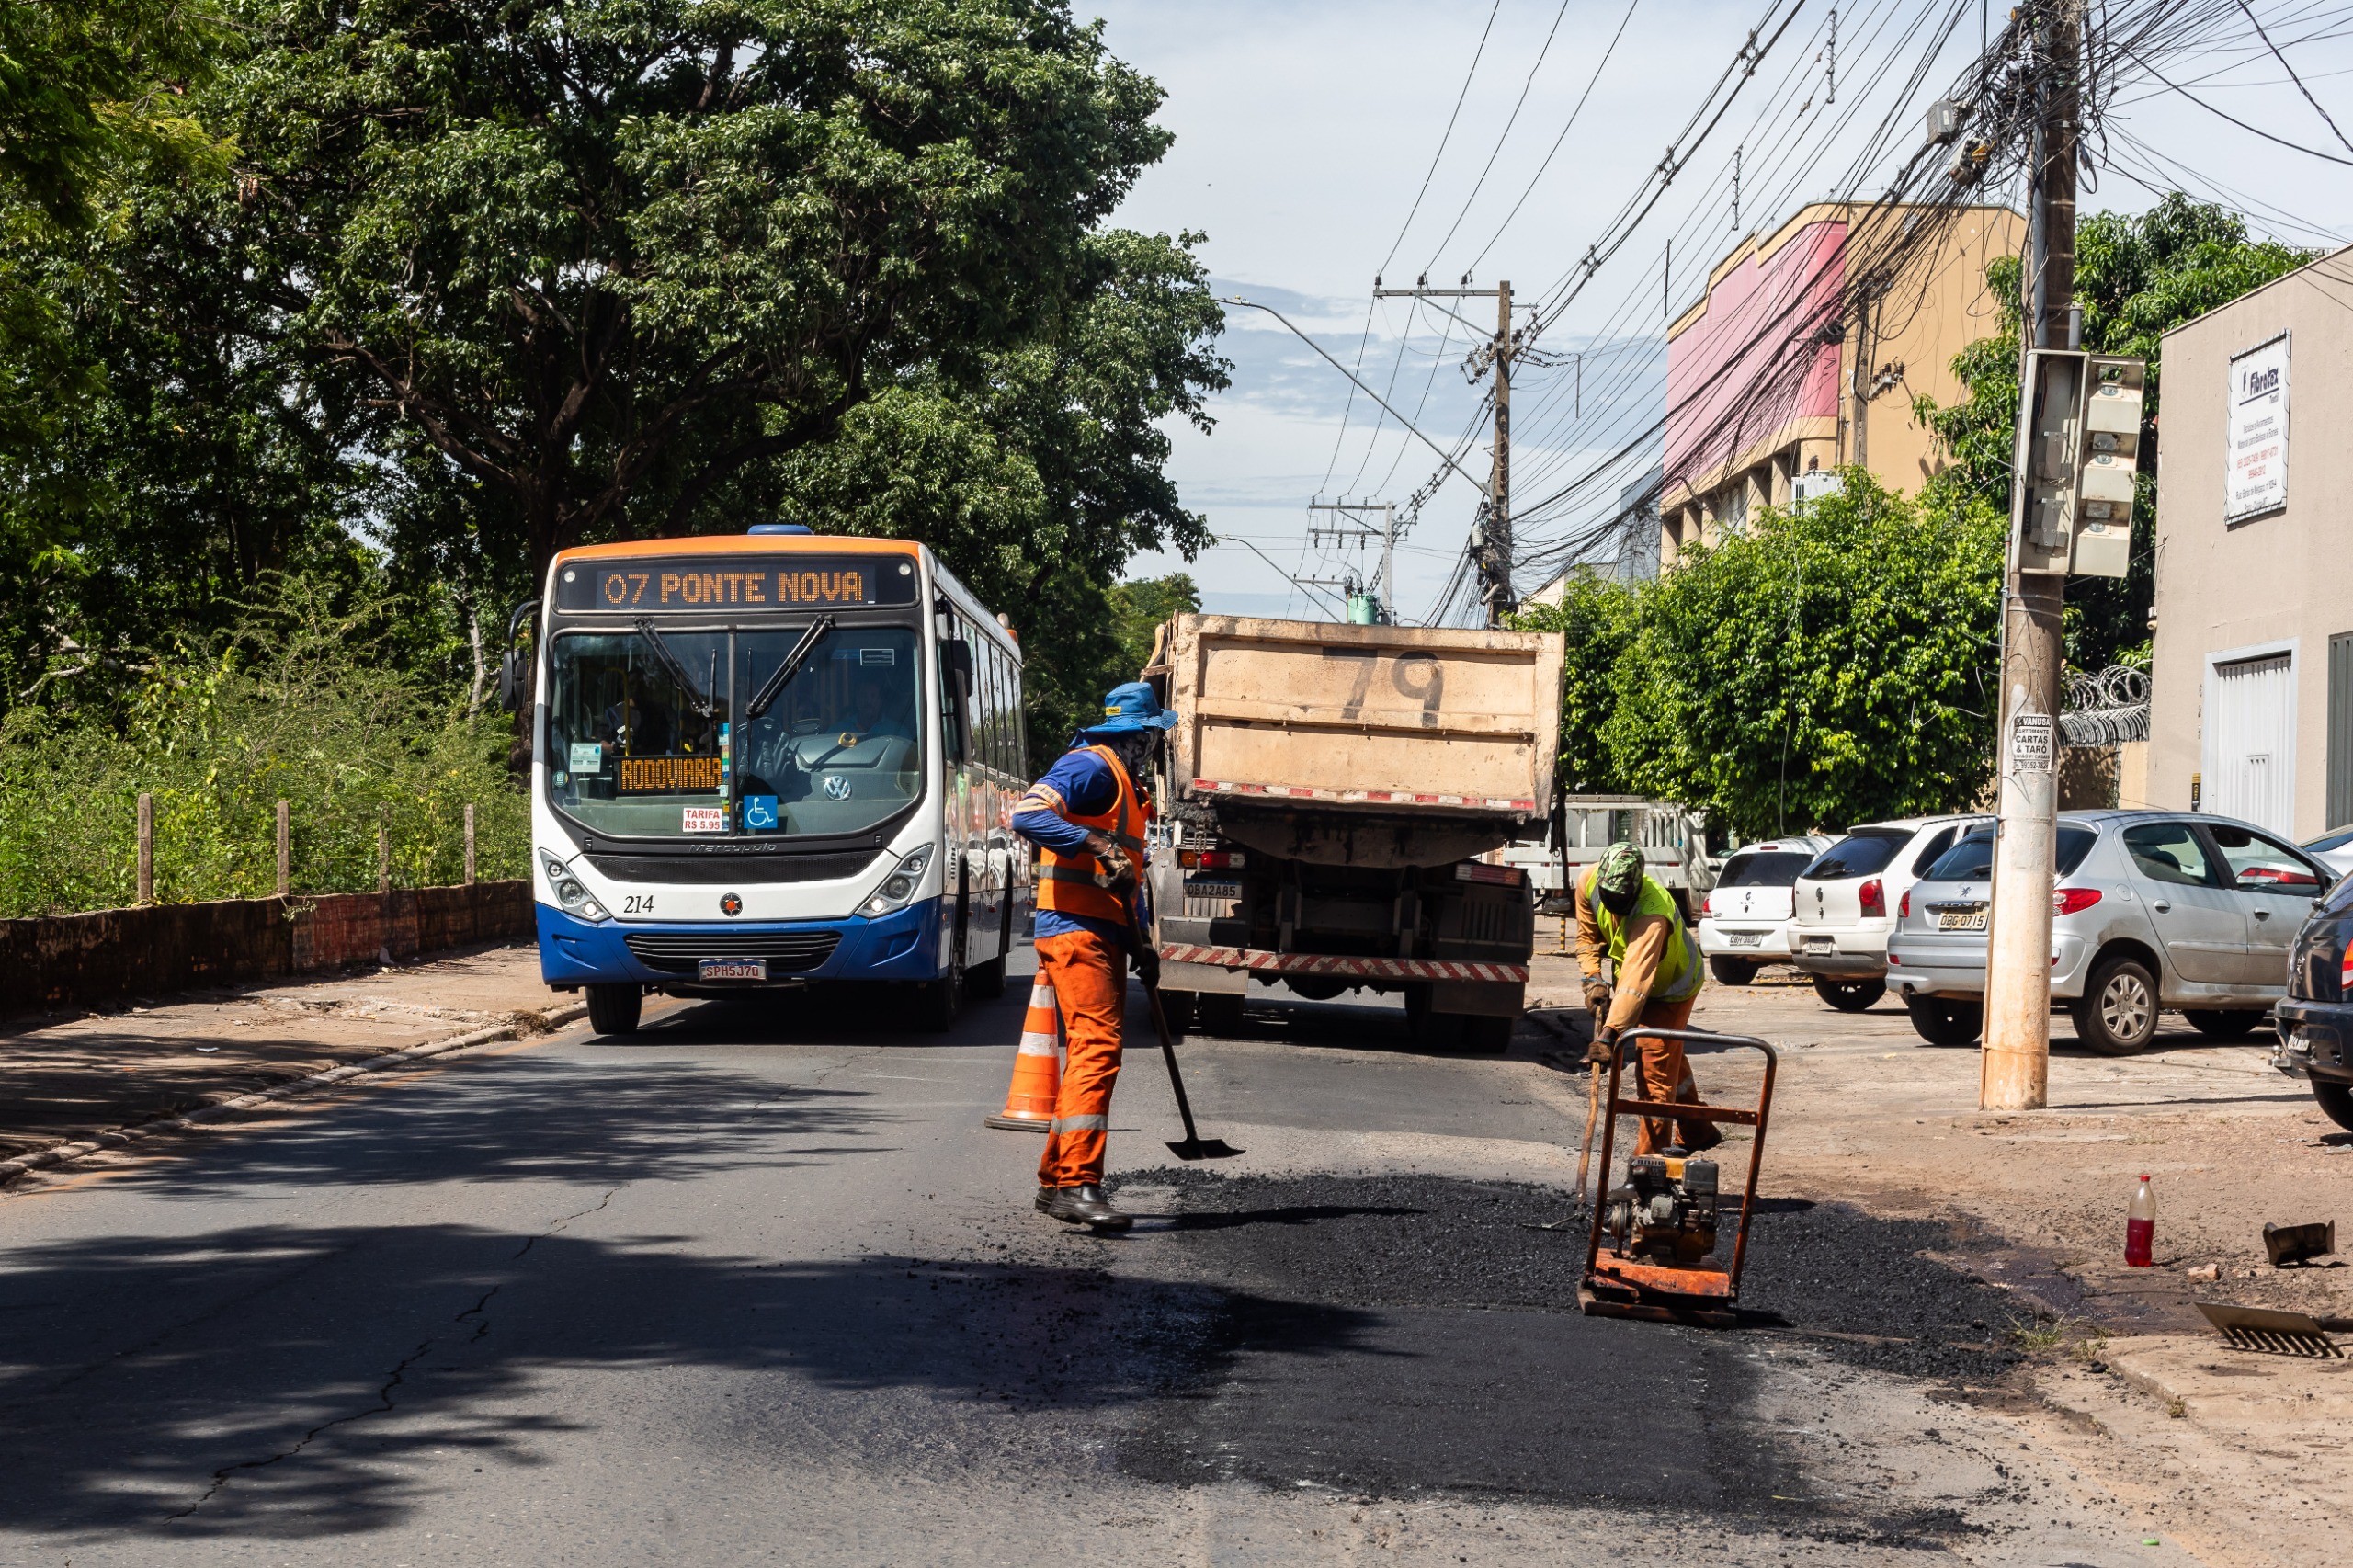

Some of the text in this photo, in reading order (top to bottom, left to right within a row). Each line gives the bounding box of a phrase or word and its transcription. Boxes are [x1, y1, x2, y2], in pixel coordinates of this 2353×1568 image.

[605, 572, 862, 603] 07 PONTE NOVA
[1322, 646, 1445, 728] 79
[2023, 717, 2050, 726] VANUSA
[2016, 735, 2048, 744] CARTAS
[621, 758, 722, 789] RODOVIARIA
[686, 810, 720, 819] TARIFA
[700, 821, 720, 829] 5.95
[689, 843, 777, 853] Marcopolo
[1188, 884, 1236, 897] OBA2A85
[624, 895, 654, 913] 214
[706, 966, 759, 977] SPH5J70
